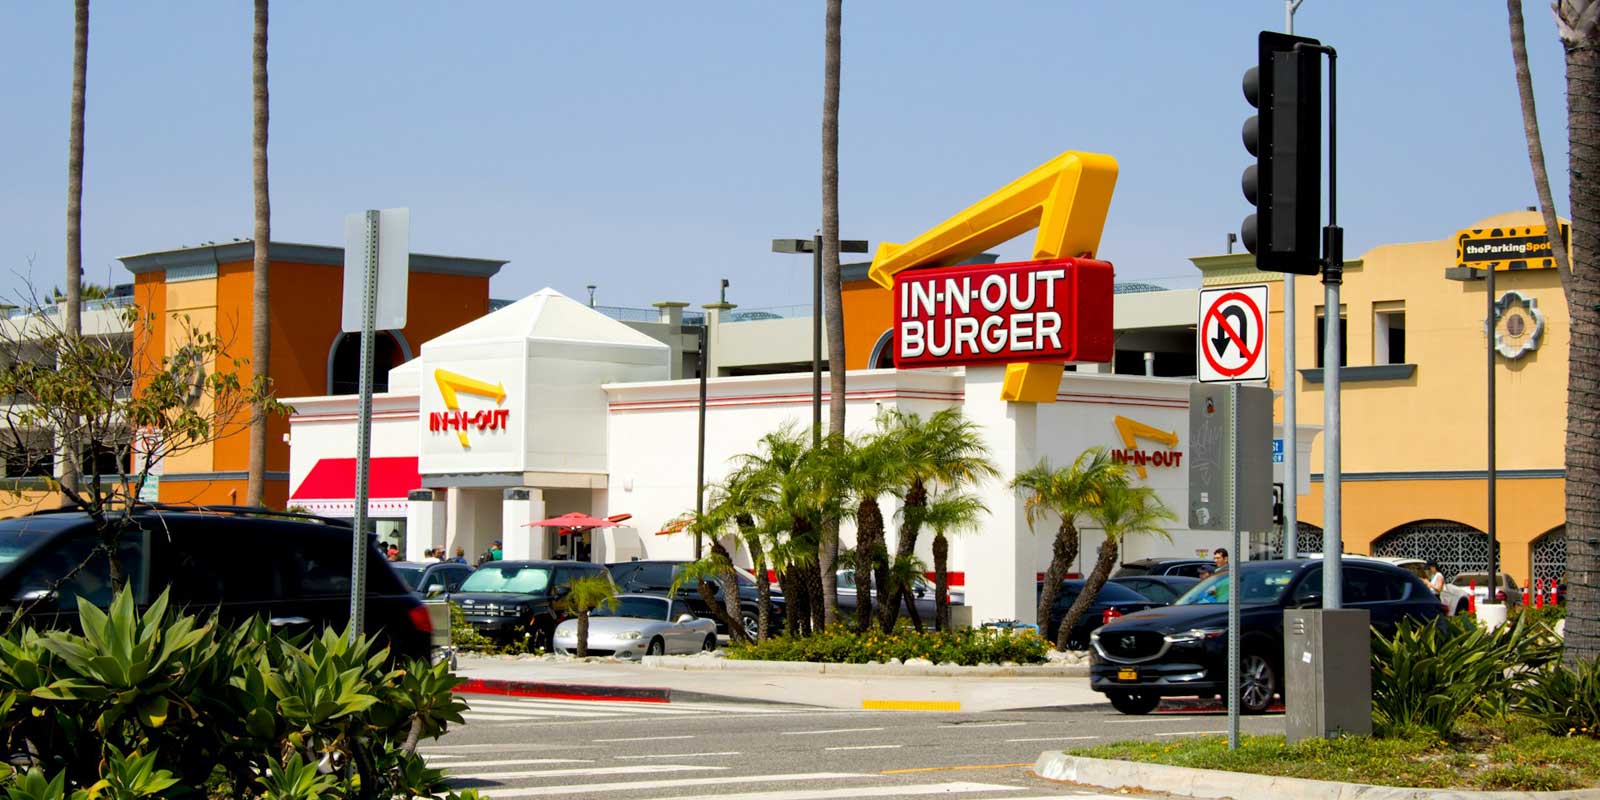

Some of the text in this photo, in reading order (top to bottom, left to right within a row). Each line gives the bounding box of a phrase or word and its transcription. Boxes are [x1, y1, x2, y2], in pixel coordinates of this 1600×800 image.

[901, 270, 1065, 318] IN-N-OUT
[901, 311, 1062, 358] BURGER
[429, 409, 510, 432] IN-N-OUT
[1111, 449, 1183, 467] IN-N-OUT
